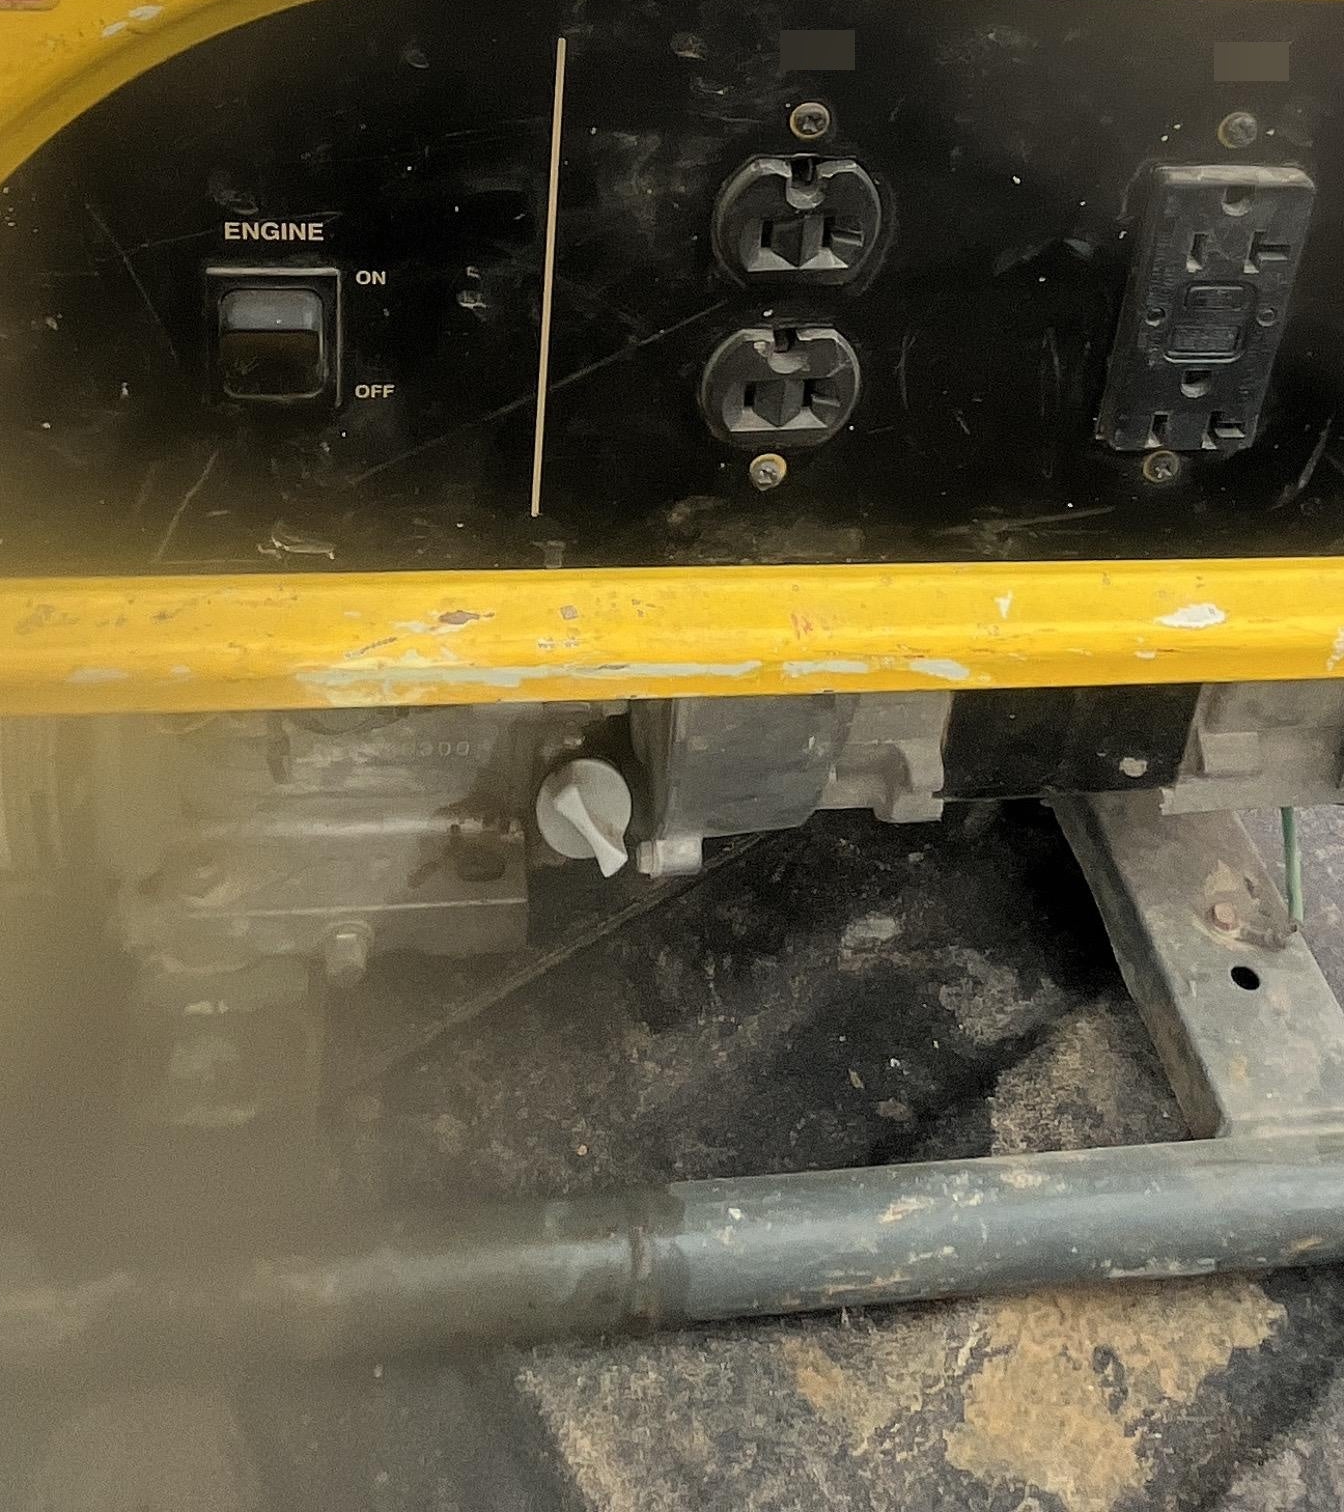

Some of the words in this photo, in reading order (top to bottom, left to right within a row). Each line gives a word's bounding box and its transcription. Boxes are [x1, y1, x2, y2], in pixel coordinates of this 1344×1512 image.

[224, 222, 325, 242] ENGINE
[356, 270, 386, 286] ON
[355, 384, 396, 399] OFF
